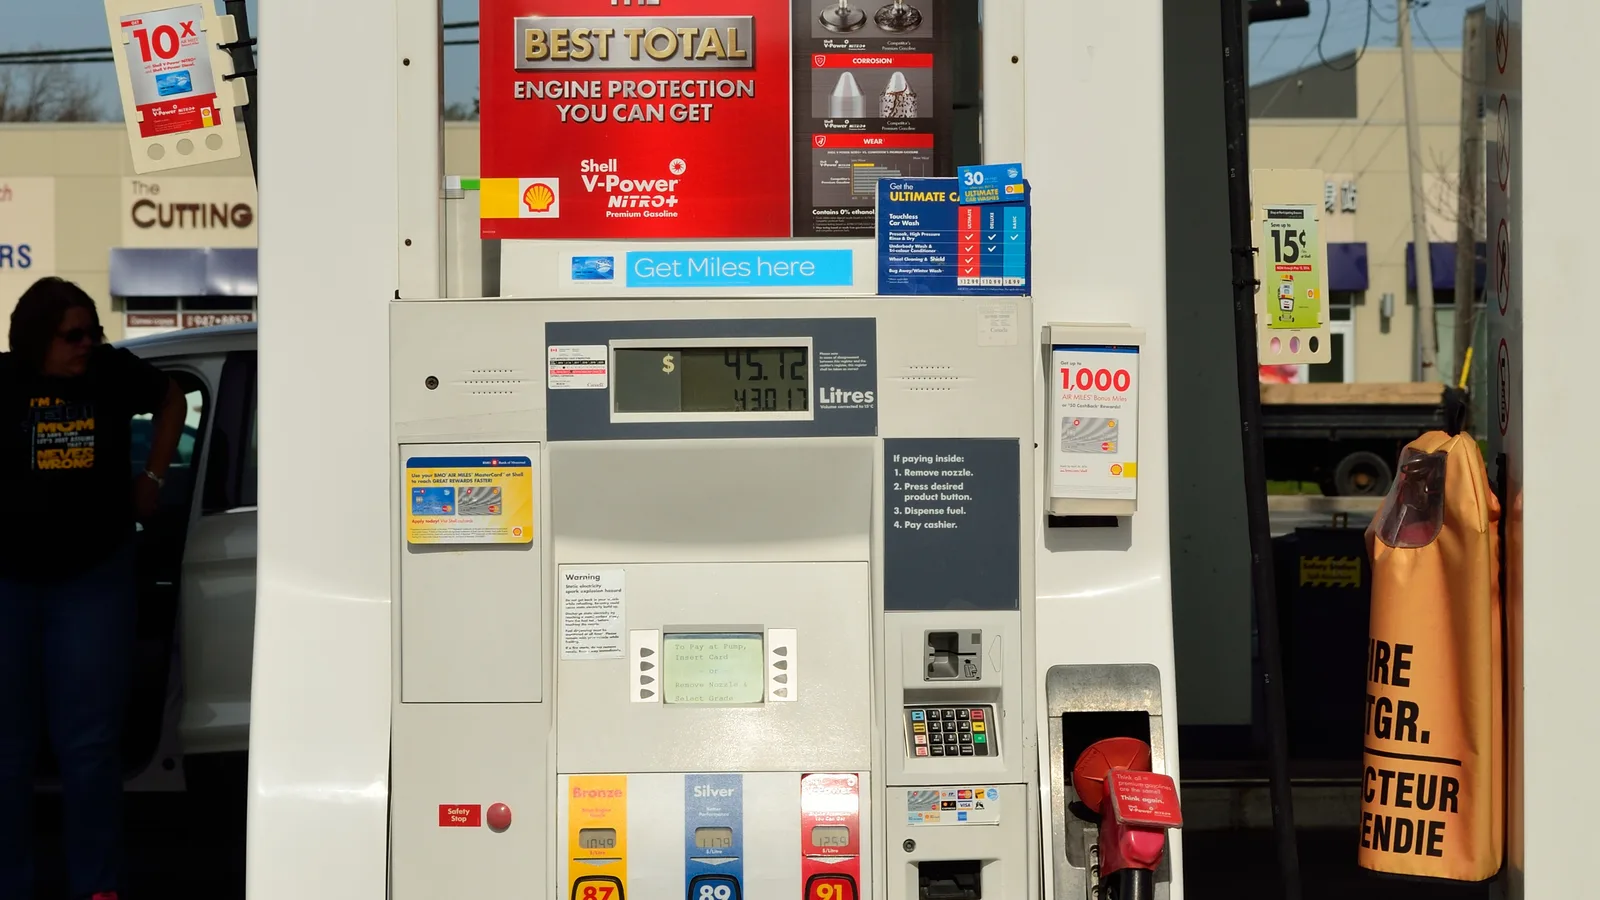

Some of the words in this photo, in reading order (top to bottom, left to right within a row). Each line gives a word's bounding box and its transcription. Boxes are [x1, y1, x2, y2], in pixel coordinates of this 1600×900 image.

[524, 27, 614, 61] BEST
[623, 26, 747, 60] TOTAL
[514, 81, 602, 99] ENGINE
[608, 79, 755, 98] PROTECTION
[556, 104, 607, 122] YOU
[613, 104, 665, 122] CAN
[669, 103, 713, 122] GET
[580, 159, 617, 172] Shell
[580, 175, 679, 193] V-Power
[903, 182, 913, 190] the
[964, 172, 984, 185] 30
[131, 180, 160, 195] The
[890, 192, 945, 201] ULTIMATE
[131, 199, 254, 229] CUTTING
[1271, 229, 1306, 263] 15¢
[634, 257, 682, 278] Get
[688, 257, 751, 277] Miles
[757, 256, 815, 276] here
[662, 353, 674, 375] $
[724, 349, 806, 380] 45.12
[1061, 368, 1130, 391] 1,000
[820, 387, 874, 403] Litres
[37, 418, 95, 432] MOM
[38, 459, 93, 469] WRONG
[902, 455, 933, 464] paying
[931, 482, 963, 490] desired
[904, 493, 938, 502] product
[904, 507, 944, 516] Dispense
[904, 521, 921, 530] Pay
[573, 787, 622, 798] Bronze
[694, 784, 736, 798] Silver
[1362, 765, 1460, 814] CTEUR
[1361, 811, 1446, 858] ENDIE
[583, 886, 614, 900] 87
[699, 885, 731, 900] 89
[816, 883, 842, 900] 91
